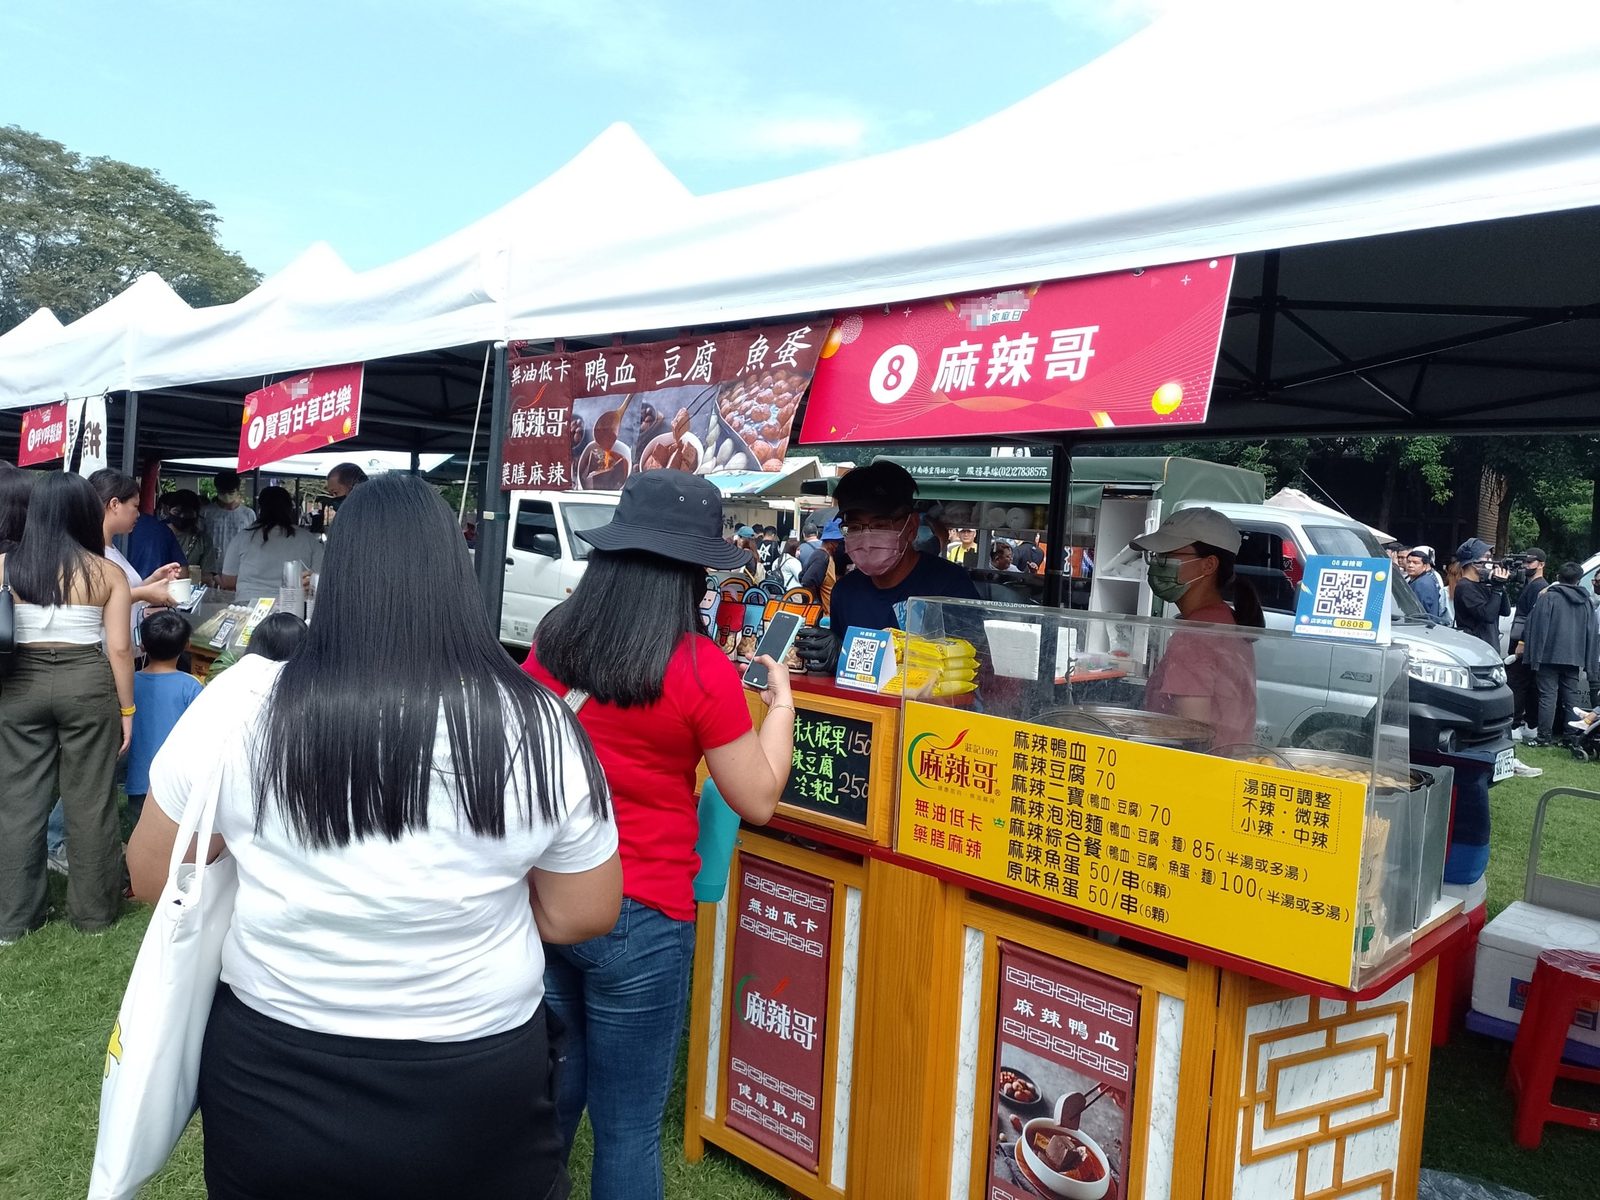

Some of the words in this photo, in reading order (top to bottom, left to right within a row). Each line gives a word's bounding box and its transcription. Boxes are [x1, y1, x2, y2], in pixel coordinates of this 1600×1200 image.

[510, 357, 571, 387] 無油低卡
[585, 353, 637, 392] 鴨血
[656, 340, 717, 385] 豆腐
[736, 325, 812, 377] 魚蛋
[930, 324, 1099, 394] 麻辣哥
[264, 384, 352, 442] 賢哥甘草芭樂
[511, 407, 568, 438] 麻辣哥
[501, 461, 569, 486] 藥膳麻辣
[1340, 619, 1365, 629] 0808
[847, 730, 872, 756] 150
[1013, 730, 1087, 763] 麻辣鴨血
[1096, 746, 1117, 767] 70
[837, 772, 869, 799] 250
[918, 748, 998, 795] 麻辣哥
[1012, 752, 1086, 786] 麻辣豆腐
[1095, 769, 1116, 790] 70
[1243, 778, 1332, 810] 湯頭可調整
[914, 798, 983, 833] 無油低卡
[1150, 804, 1171, 826] 70
[913, 823, 982, 860] 藥膳麻辣
[1007, 839, 1080, 877] 麻辣魚蛋
[1006, 860, 1079, 900] 原味魚蛋
[747, 897, 819, 934] 無油低卡
[744, 991, 817, 1051] 麻辣哥
[1012, 998, 1120, 1052] 麻辣鴨血
[737, 1082, 806, 1130] 健康取向
